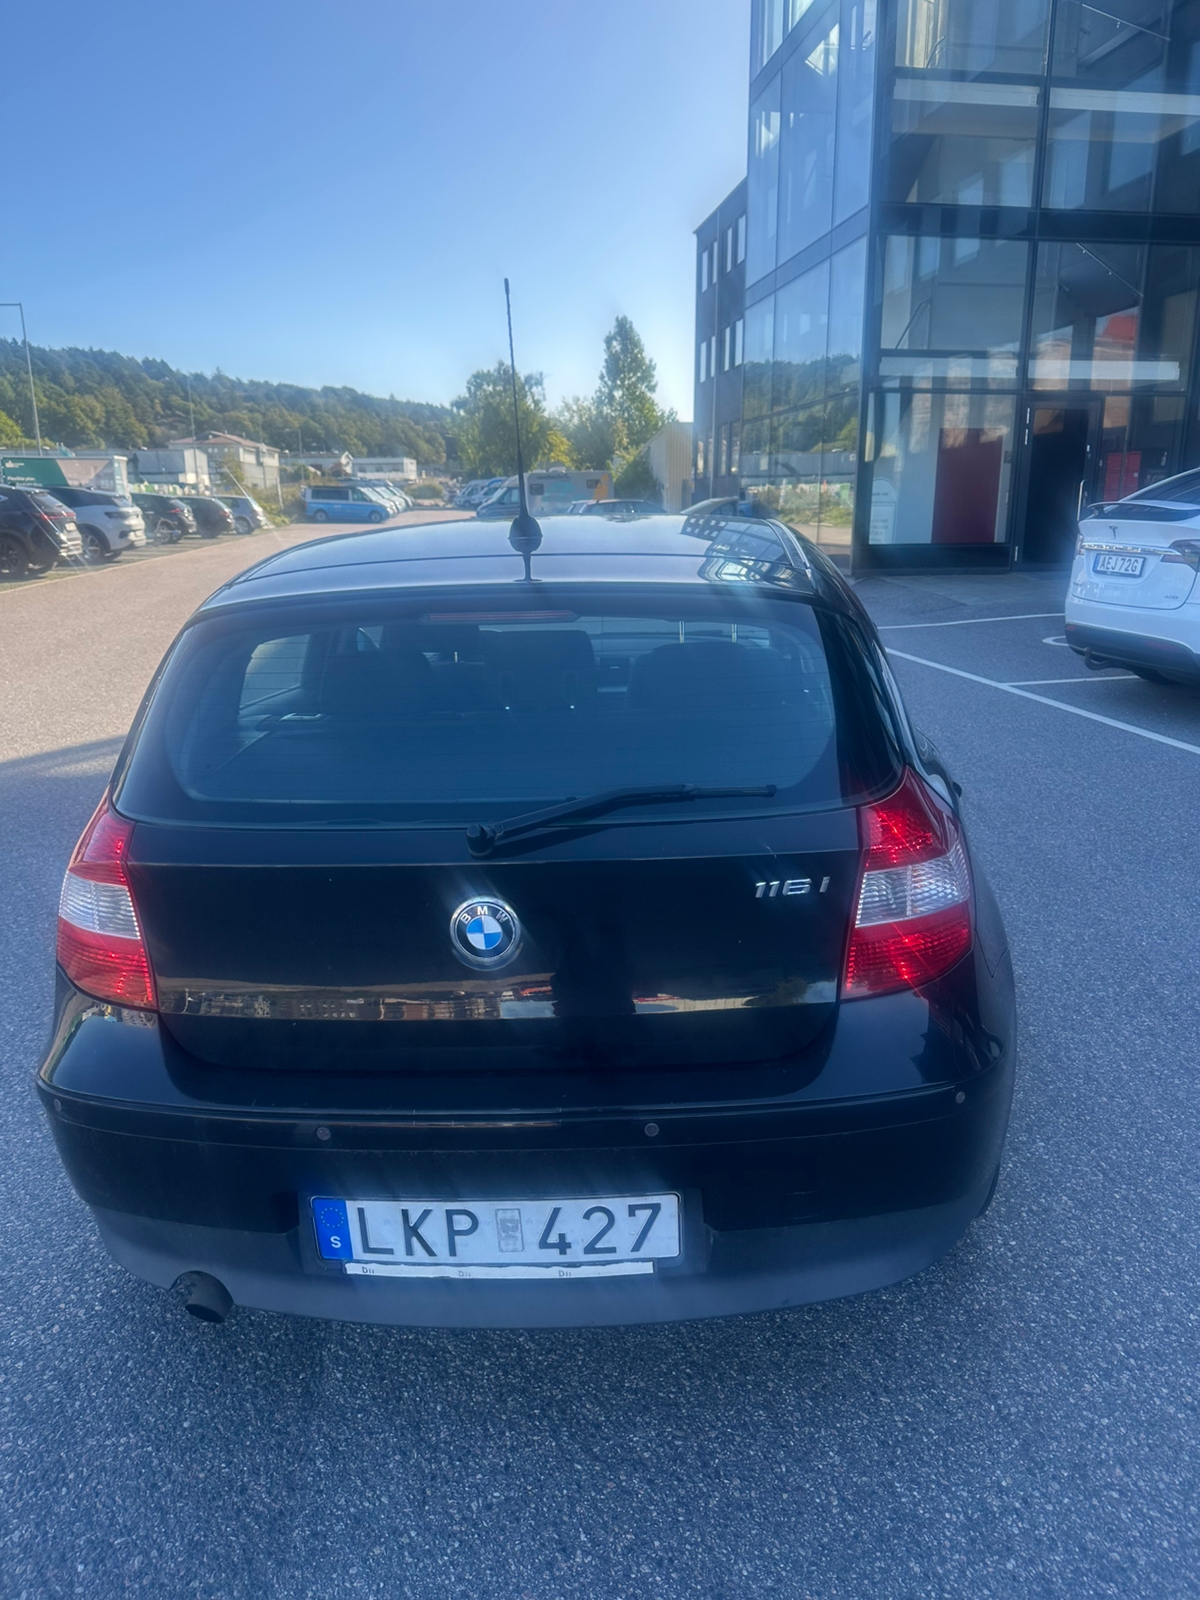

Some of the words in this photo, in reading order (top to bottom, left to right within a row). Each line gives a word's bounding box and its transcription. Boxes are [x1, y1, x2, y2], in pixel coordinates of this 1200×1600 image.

[1100, 556, 1118, 570] AEJ
[1118, 558, 1138, 572] 72G
[460, 905, 508, 925] BMW
[357, 1206, 480, 1256] LKP
[538, 1202, 662, 1255] 427
[330, 1235, 342, 1249] S
